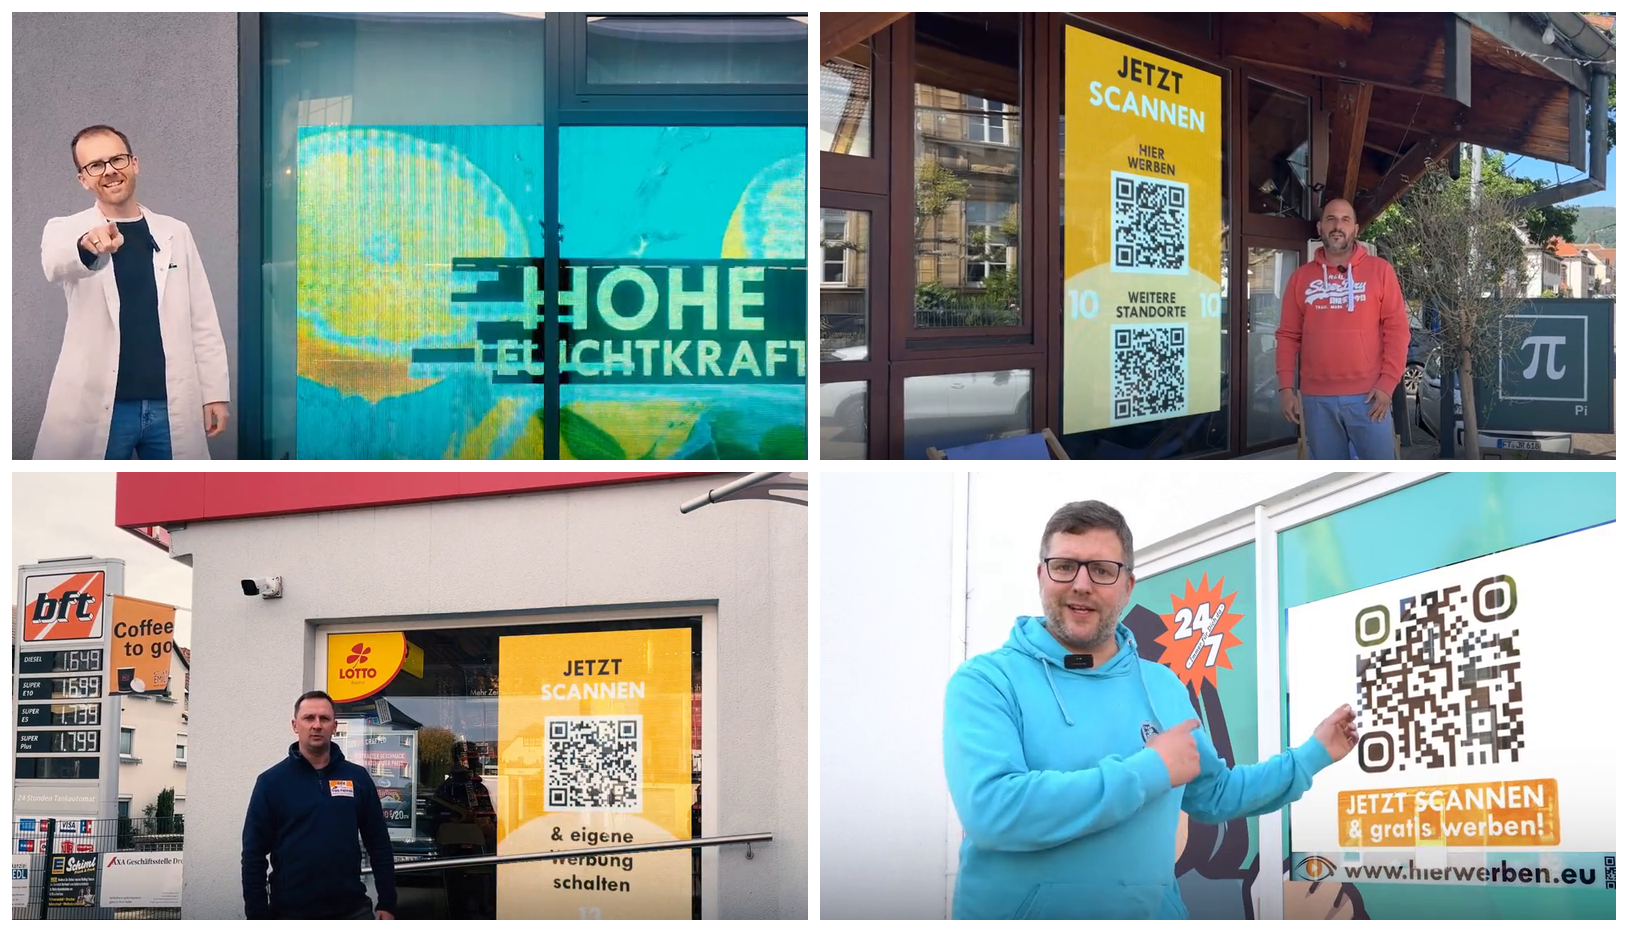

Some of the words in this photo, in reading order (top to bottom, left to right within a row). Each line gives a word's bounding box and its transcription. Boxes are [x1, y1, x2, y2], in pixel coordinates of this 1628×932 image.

[1117, 55, 1183, 94] JETZT
[1089, 80, 1205, 133] SCANNEN
[1138, 143, 1165, 160] HIER
[1127, 156, 1176, 176] WERBEN
[523, 266, 765, 331] HOHE
[1069, 289, 1099, 320] 10
[1128, 291, 1176, 304] WEITERE
[1199, 291, 1221, 318] 10
[1116, 305, 1187, 318] STANDORTE
[1575, 405, 1588, 416] Pi
[32, 590, 95, 624] bft
[114, 618, 174, 639] Coffee
[124, 641, 144, 657] to
[150, 640, 173, 659] go
[63, 650, 100, 671] 1.649
[563, 659, 622, 676] JETZT
[339, 668, 377, 679] LOTTO
[62, 677, 99, 698] 1.699
[541, 681, 646, 700] SCANNEN
[61, 703, 99, 724] 1.739
[60, 731, 97, 752] 1.799
[1346, 792, 1407, 815] JETZT
[1415, 784, 1545, 812] SCANNEN
[61, 820, 76, 829] VISA
[1348, 819, 1362, 838] &
[1370, 815, 1433, 843] gratis
[1441, 812, 1545, 836] werben!
[551, 826, 564, 841] &
[570, 826, 634, 846] eigene
[553, 873, 630, 892] schalten
[1345, 859, 1596, 886] www.hierwerben.eu
